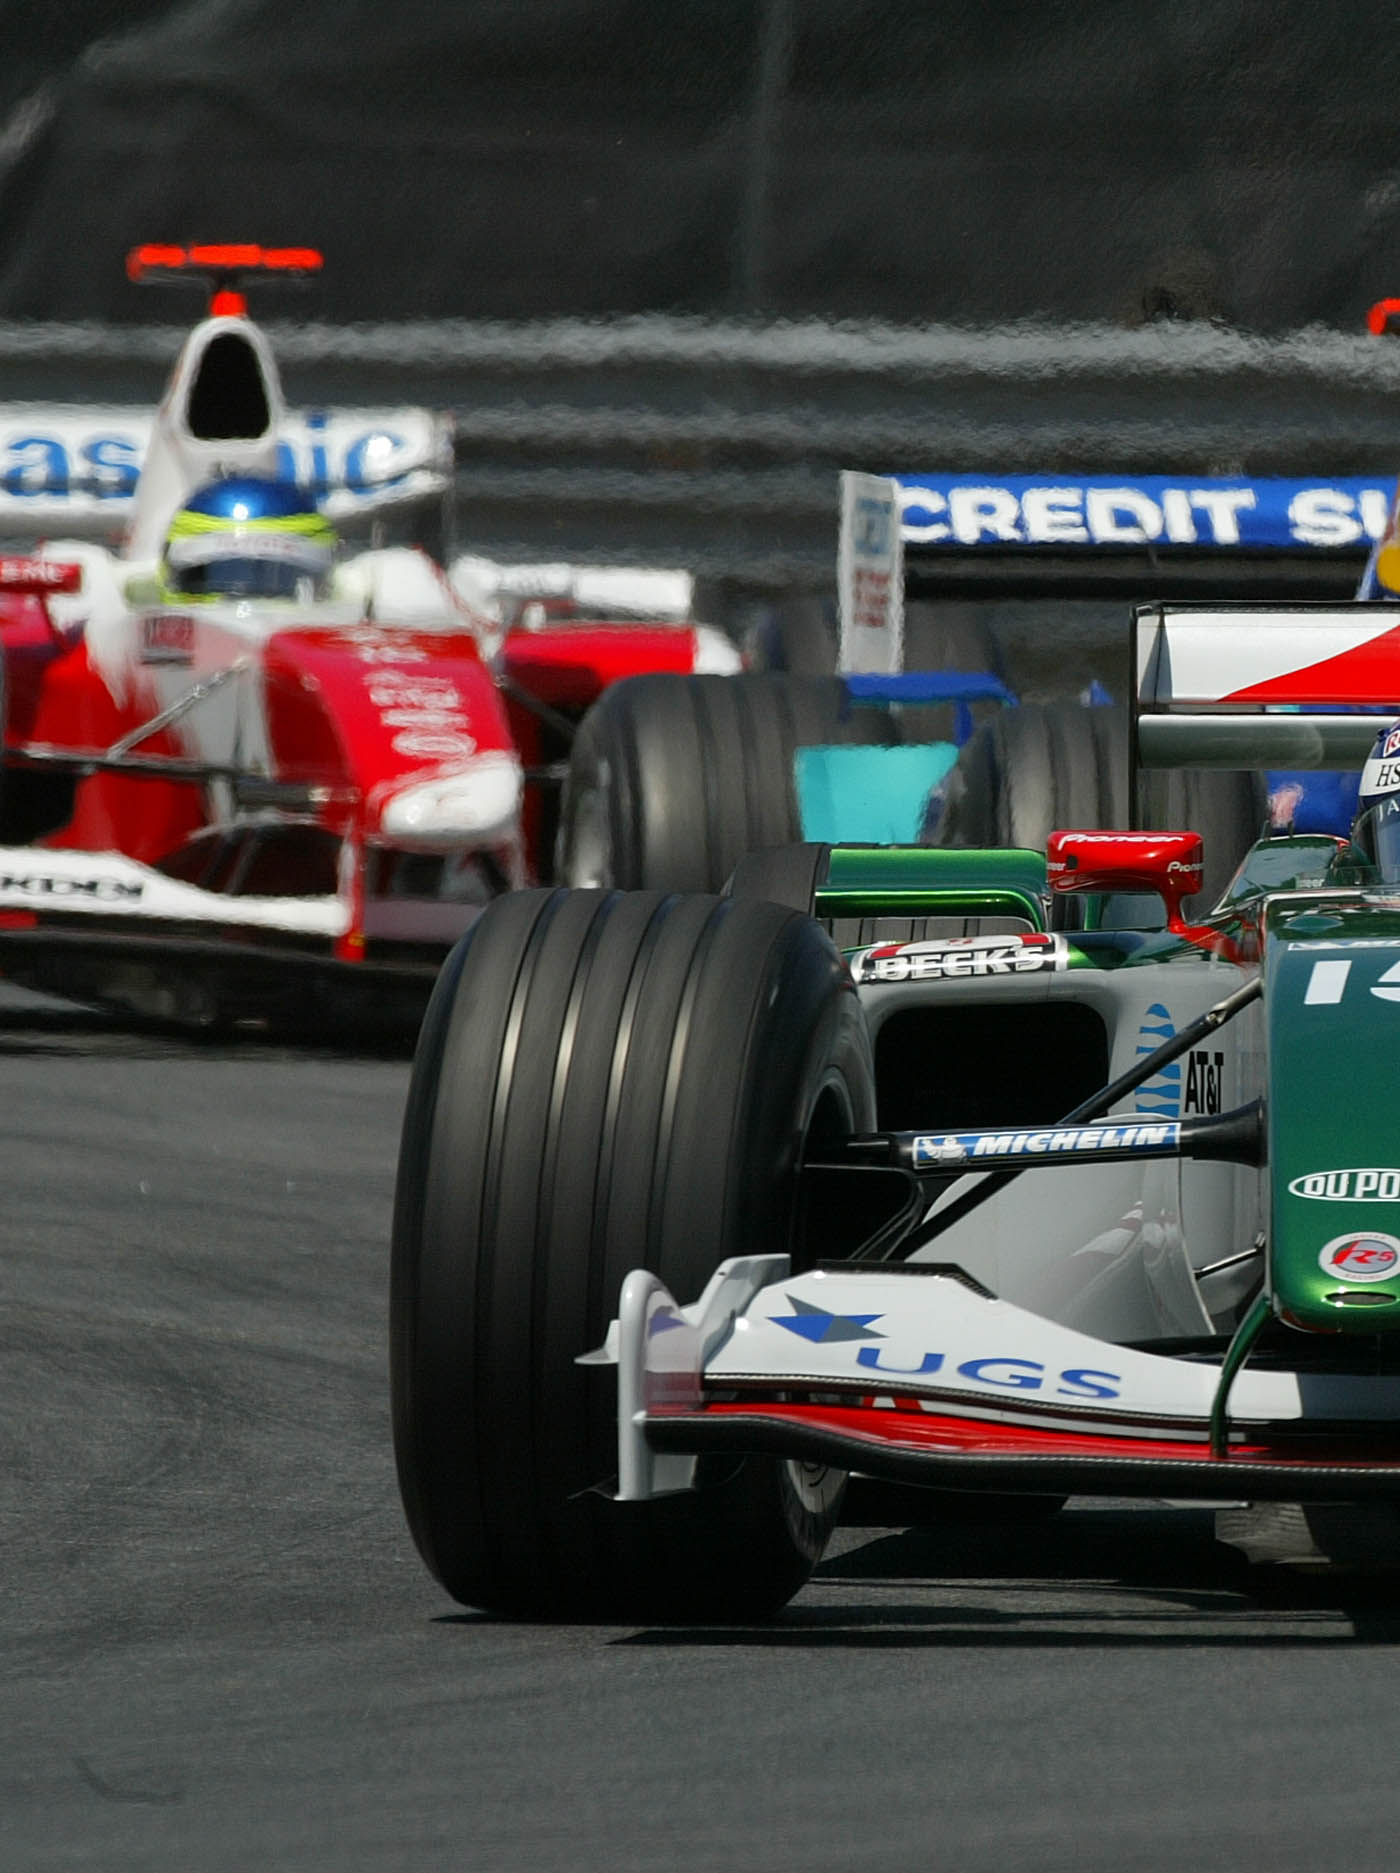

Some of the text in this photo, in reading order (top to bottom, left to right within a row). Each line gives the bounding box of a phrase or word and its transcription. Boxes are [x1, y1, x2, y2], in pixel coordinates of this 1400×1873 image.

[898, 487, 1256, 544] CREDIT
[1057, 833, 1184, 851] Pioneer
[1184, 1051, 1224, 1114] AT&T
[973, 1125, 1168, 1156] MICHELIN
[856, 1347, 1123, 1400] UGS
